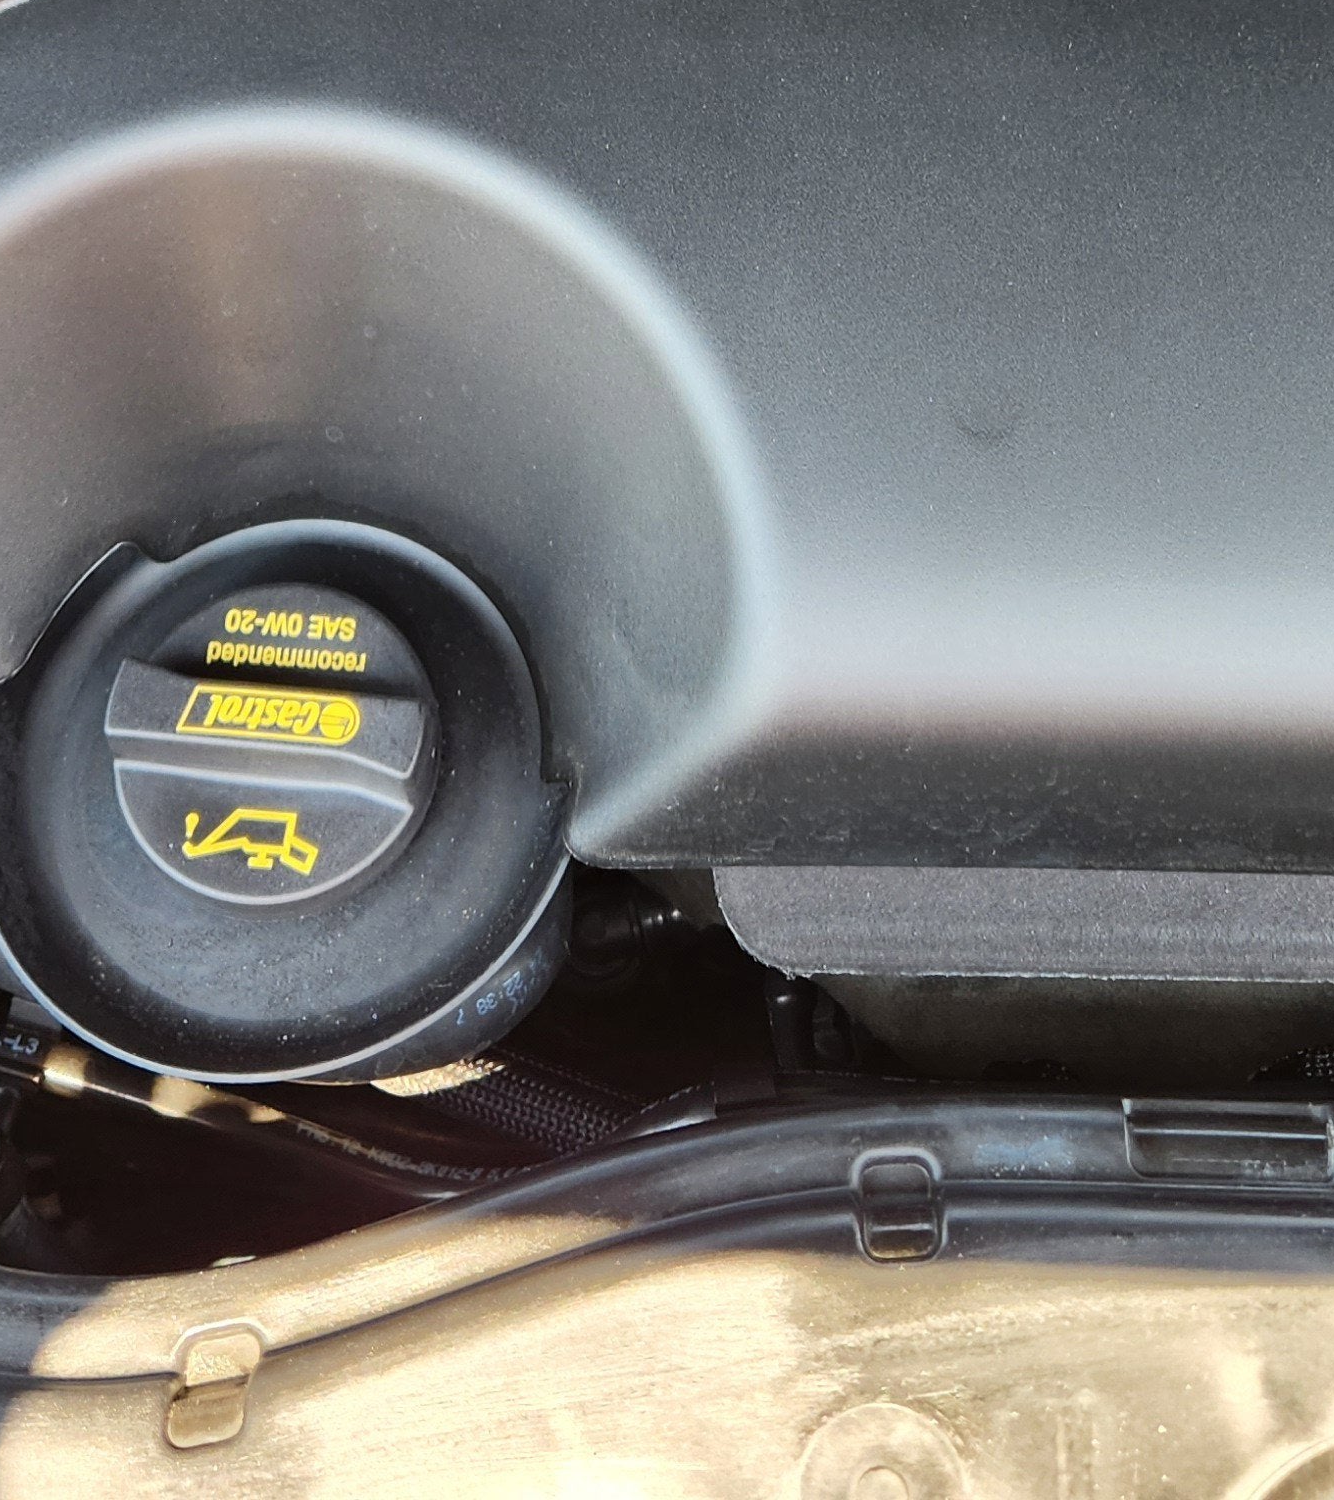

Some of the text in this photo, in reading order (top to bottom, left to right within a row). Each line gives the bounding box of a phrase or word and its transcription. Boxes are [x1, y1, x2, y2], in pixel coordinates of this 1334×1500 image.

[224, 607, 356, 642] SAE 0W-20
[205, 640, 367, 673] recommended
[203, 693, 320, 736] Castrol
